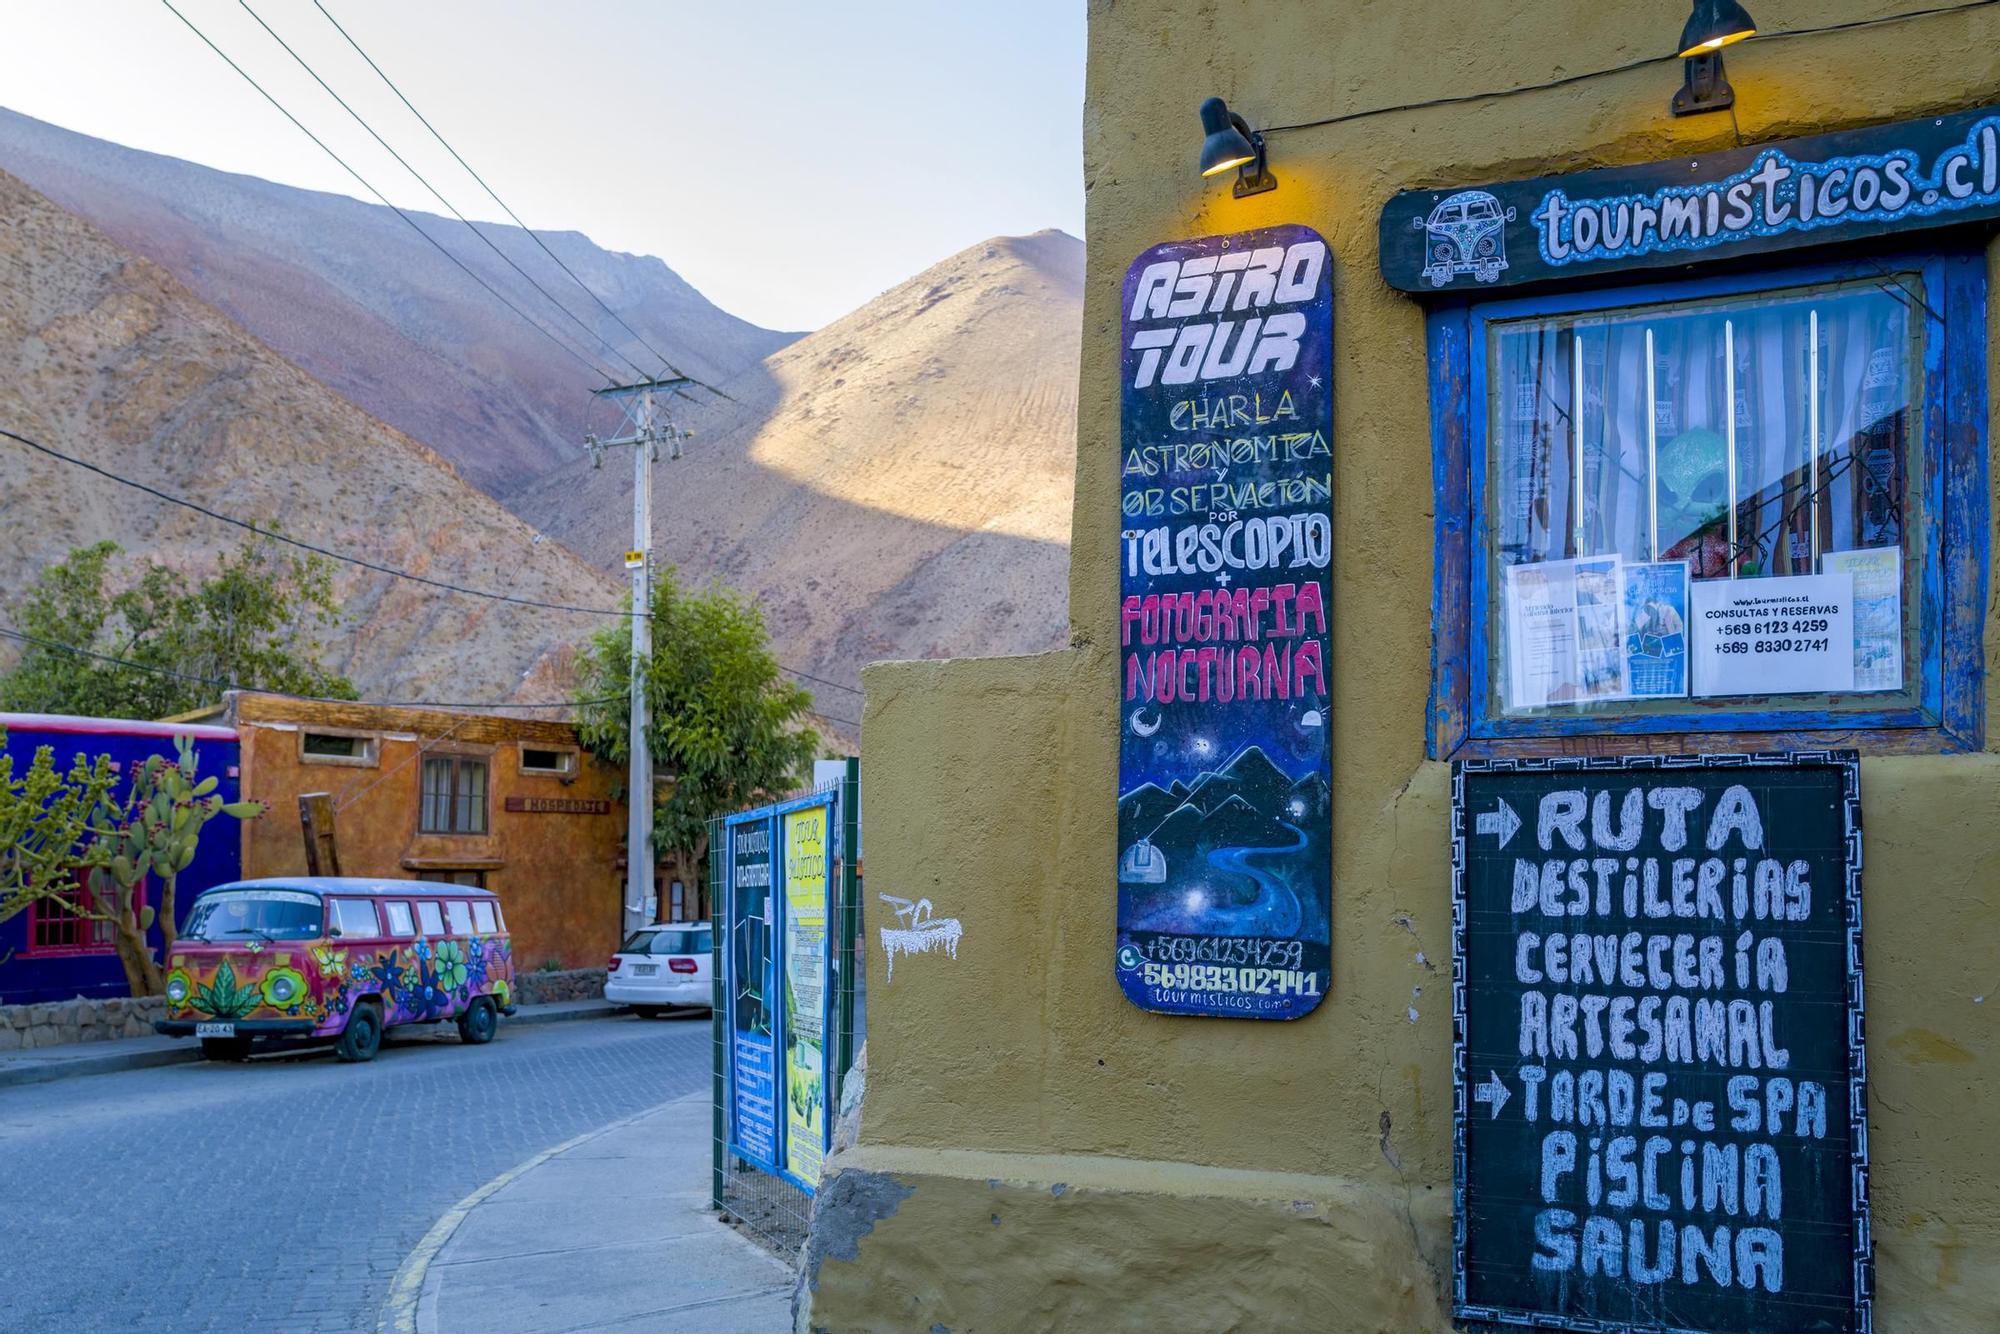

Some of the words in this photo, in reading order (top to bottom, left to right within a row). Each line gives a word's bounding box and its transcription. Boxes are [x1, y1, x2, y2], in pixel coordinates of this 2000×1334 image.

[1540, 126, 1997, 259] tourmisticos.cl
[1130, 241, 1326, 321] ASTRO
[1130, 312, 1306, 389] TOUR
[1170, 389, 1300, 431] CHARLA
[1215, 467, 1229, 482] Y
[1209, 511, 1238, 523] POR
[1121, 581, 1326, 647] FOTOGRAFIA
[1705, 608, 1769, 619] CONSULTAS
[1772, 607, 1779, 617] Y
[1780, 605, 1839, 616] RESERVAS
[1716, 623, 1751, 635] +569
[1754, 621, 1788, 634] 6123
[1792, 619, 1828, 633] 4259
[1127, 640, 1326, 704] NOCTURNA
[1714, 641, 1748, 654] +569
[1537, 784, 1764, 852] RUTA
[1519, 990, 1789, 1068] ARTESANAL
[1518, 1065, 1668, 1127] TARDE
[1727, 1075, 1827, 1138] SPA
[1532, 1207, 1784, 1293] SAUNA
